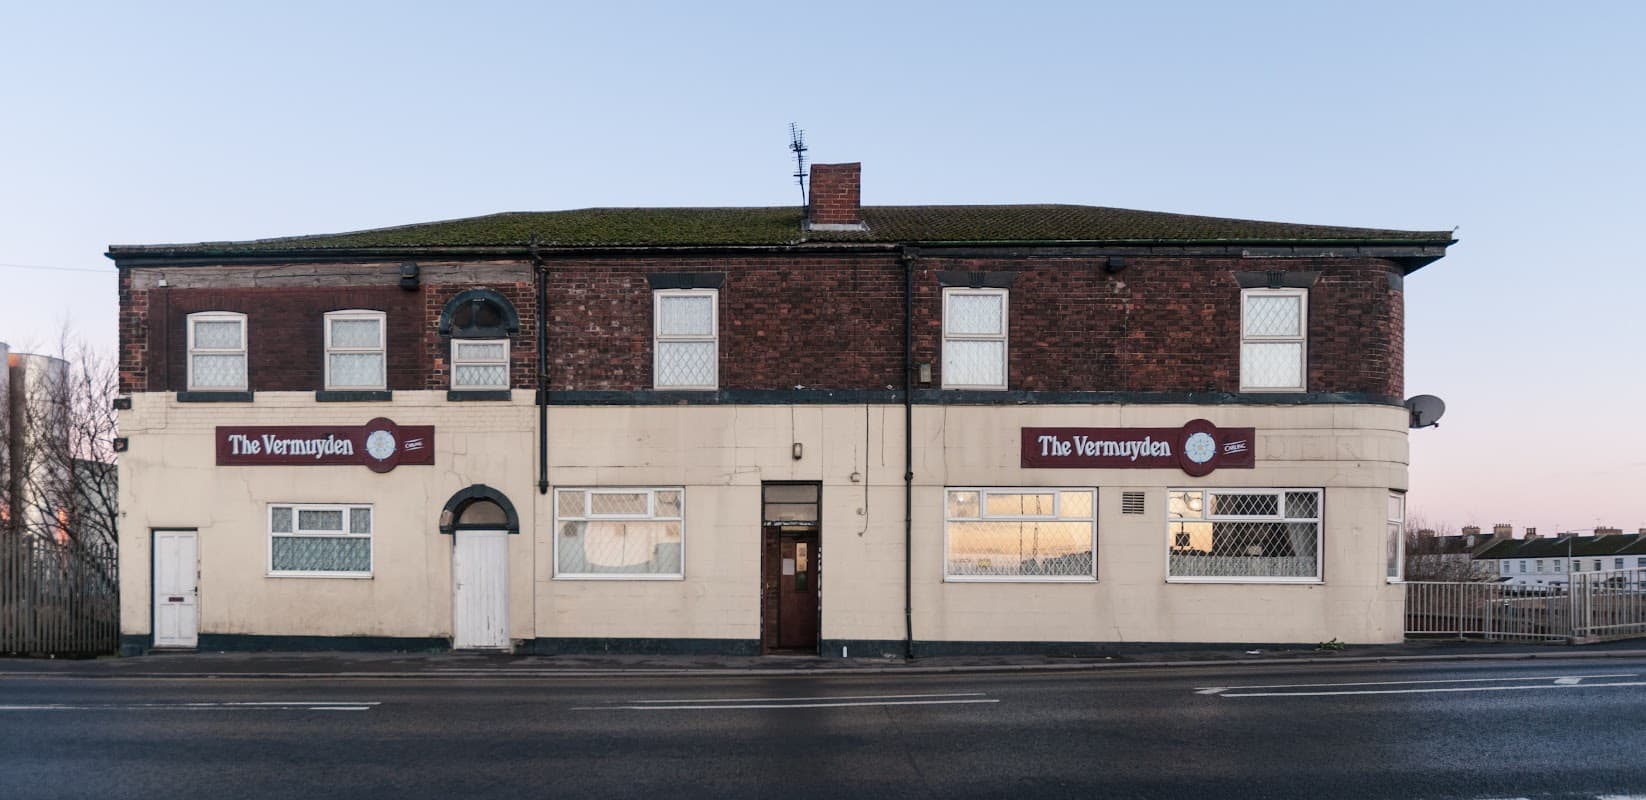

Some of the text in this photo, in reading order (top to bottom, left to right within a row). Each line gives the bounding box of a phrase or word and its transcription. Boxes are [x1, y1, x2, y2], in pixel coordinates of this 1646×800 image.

[228, 434, 354, 459] The Vermuyden
[1037, 435, 1172, 461] The Vermuyden
